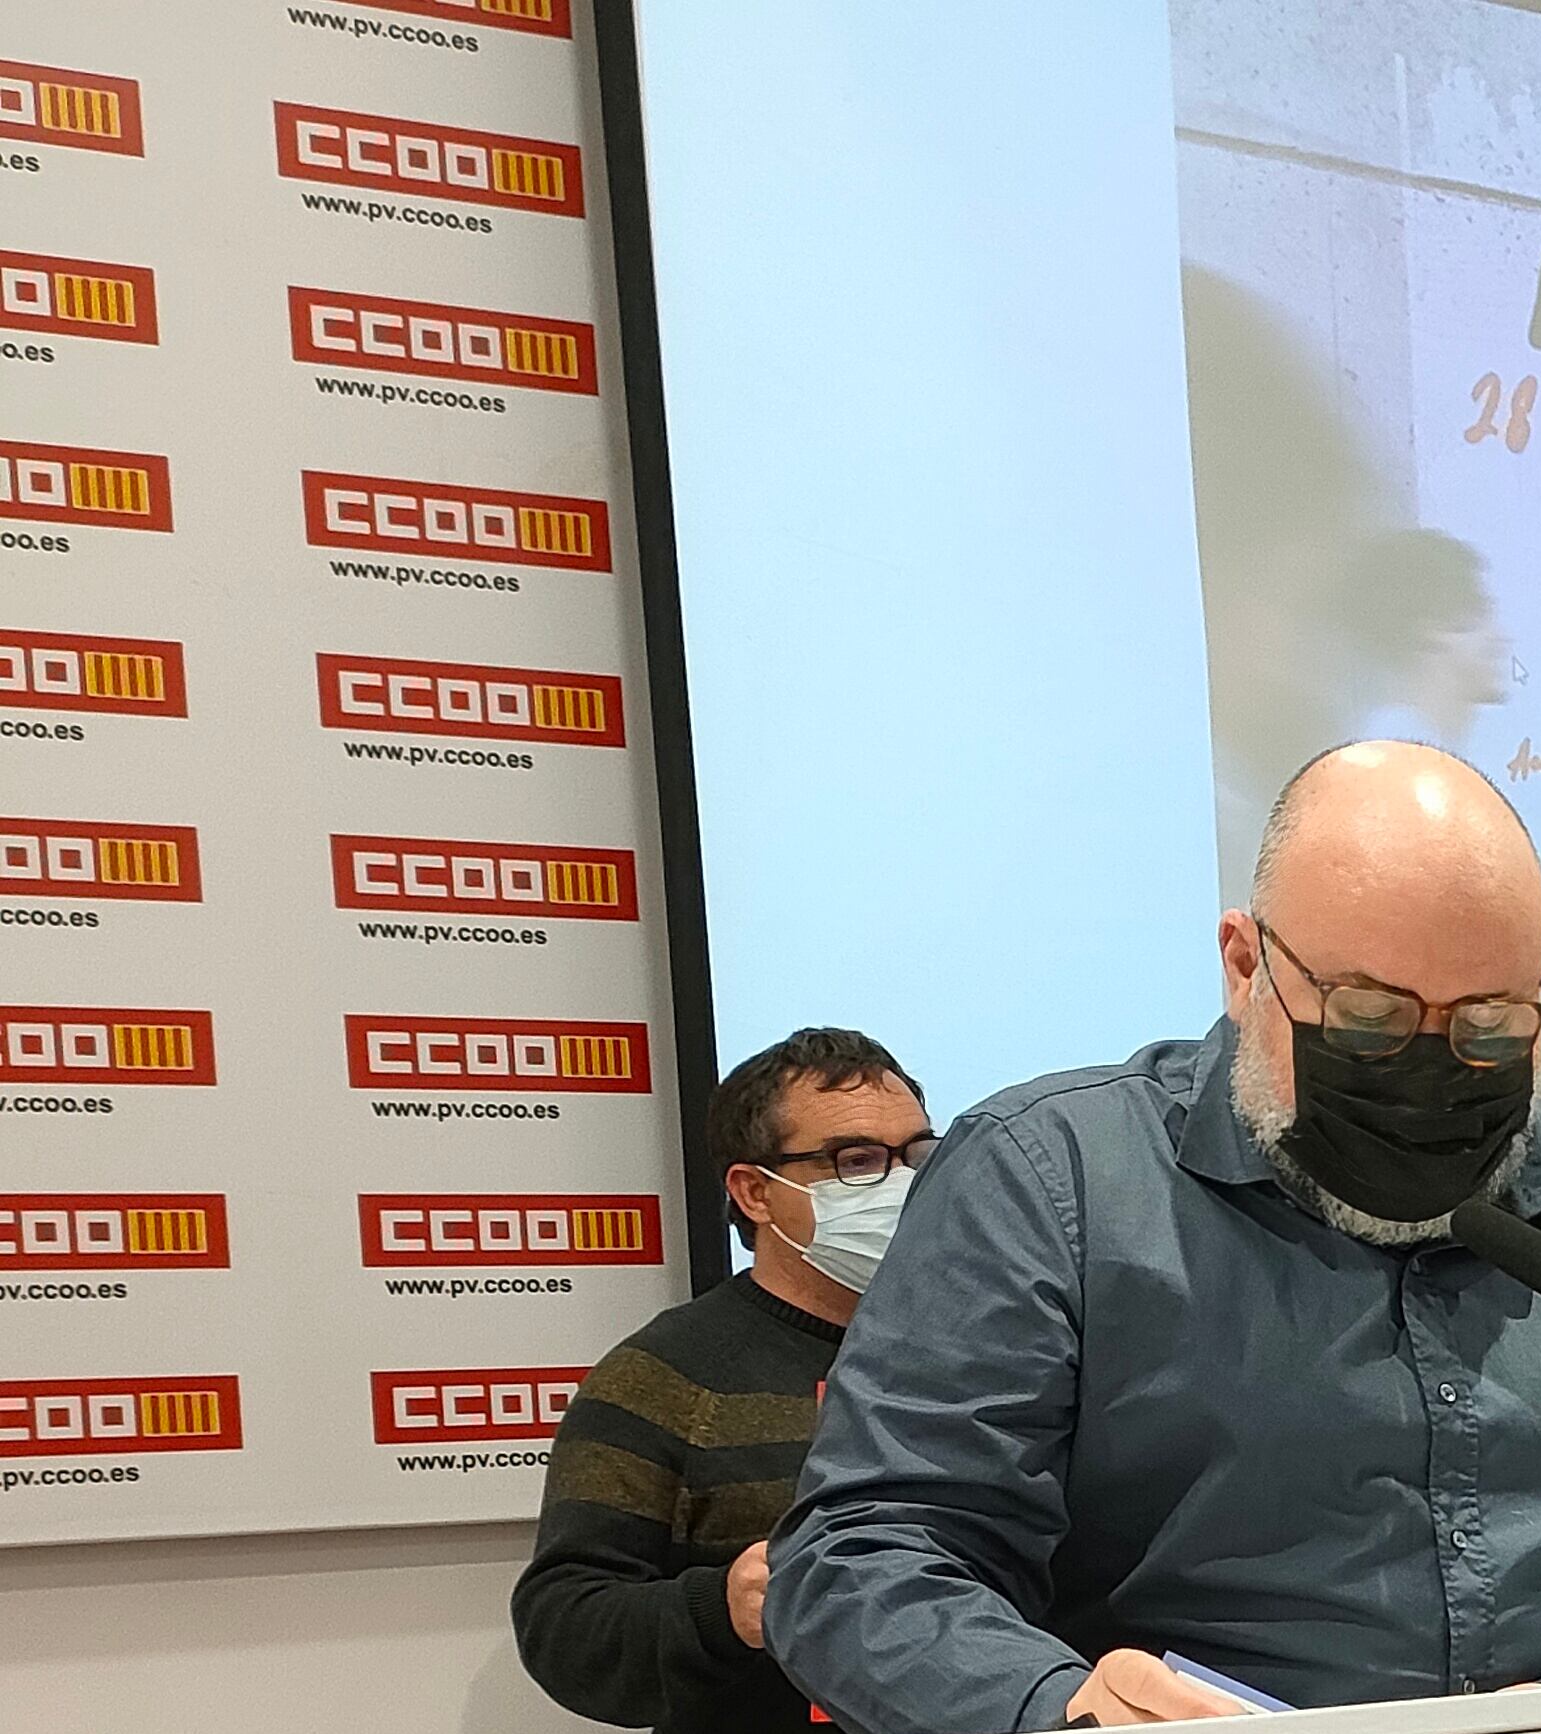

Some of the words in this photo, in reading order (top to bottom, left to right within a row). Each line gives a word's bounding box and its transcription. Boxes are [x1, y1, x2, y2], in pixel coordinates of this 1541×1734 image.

[288, 5, 478, 52] www.pv.ccoo.es
[297, 120, 488, 190] CCOO
[302, 192, 492, 235] www.pv.ccoo.es
[311, 305, 502, 369] CCOO
[316, 374, 506, 413] www.pv.ccoo.es
[1464, 372, 1538, 453] 28
[325, 488, 515, 548] CCOO
[330, 558, 520, 593] www.pv.ccoo.es
[339, 670, 530, 726] CCOO
[344, 741, 534, 770] www.pv.ccoo.es
[354, 852, 543, 902] CCOO
[359, 919, 547, 946] www.pv.ccoo.es
[368, 1032, 557, 1076] CCOO
[373, 1097, 560, 1122] www.pv.ccoo.es
[381, 1210, 570, 1251] CCOO
[386, 1274, 572, 1299] www.pv.ccoo.es
